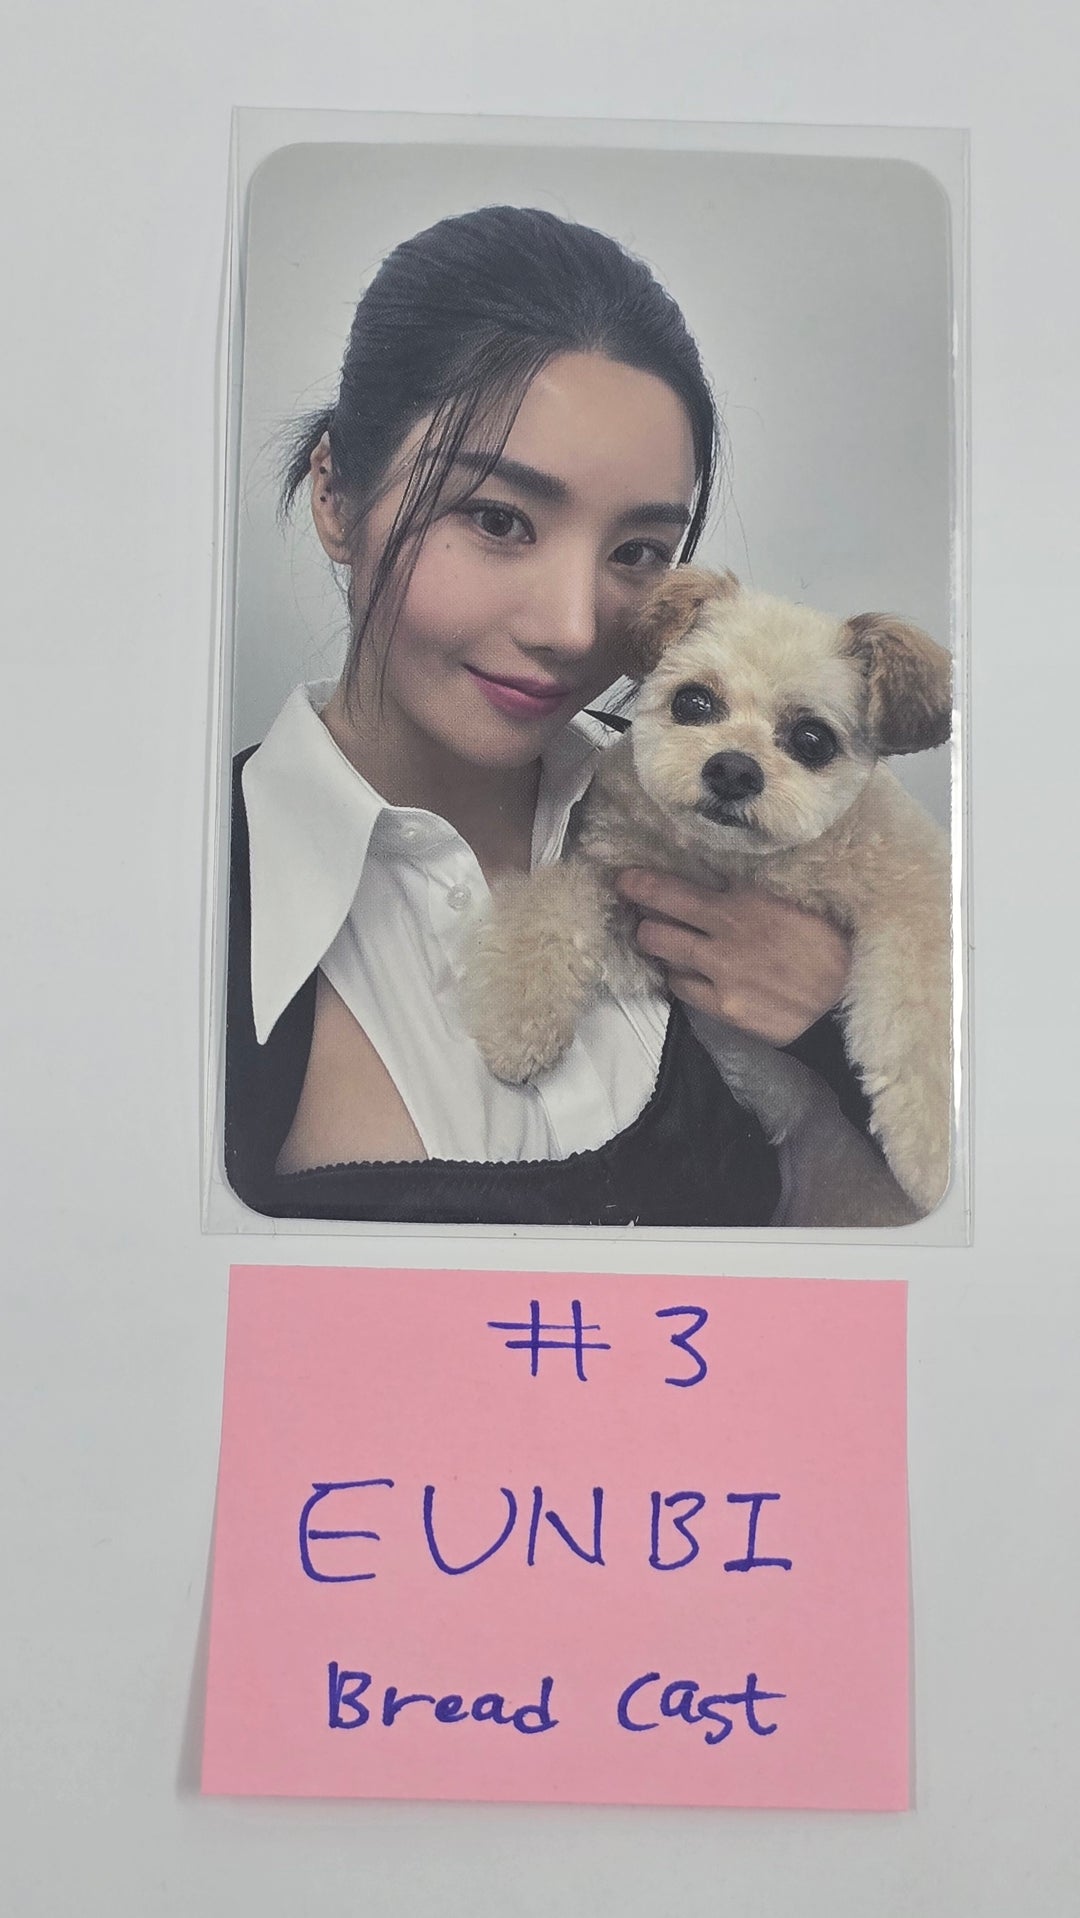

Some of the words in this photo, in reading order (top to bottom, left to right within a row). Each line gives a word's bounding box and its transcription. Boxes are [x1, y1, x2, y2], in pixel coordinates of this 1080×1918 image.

[298, 1478, 793, 1584] EUNBI
[327, 1660, 560, 1735] Bread
[616, 1671, 787, 1746] Cast
